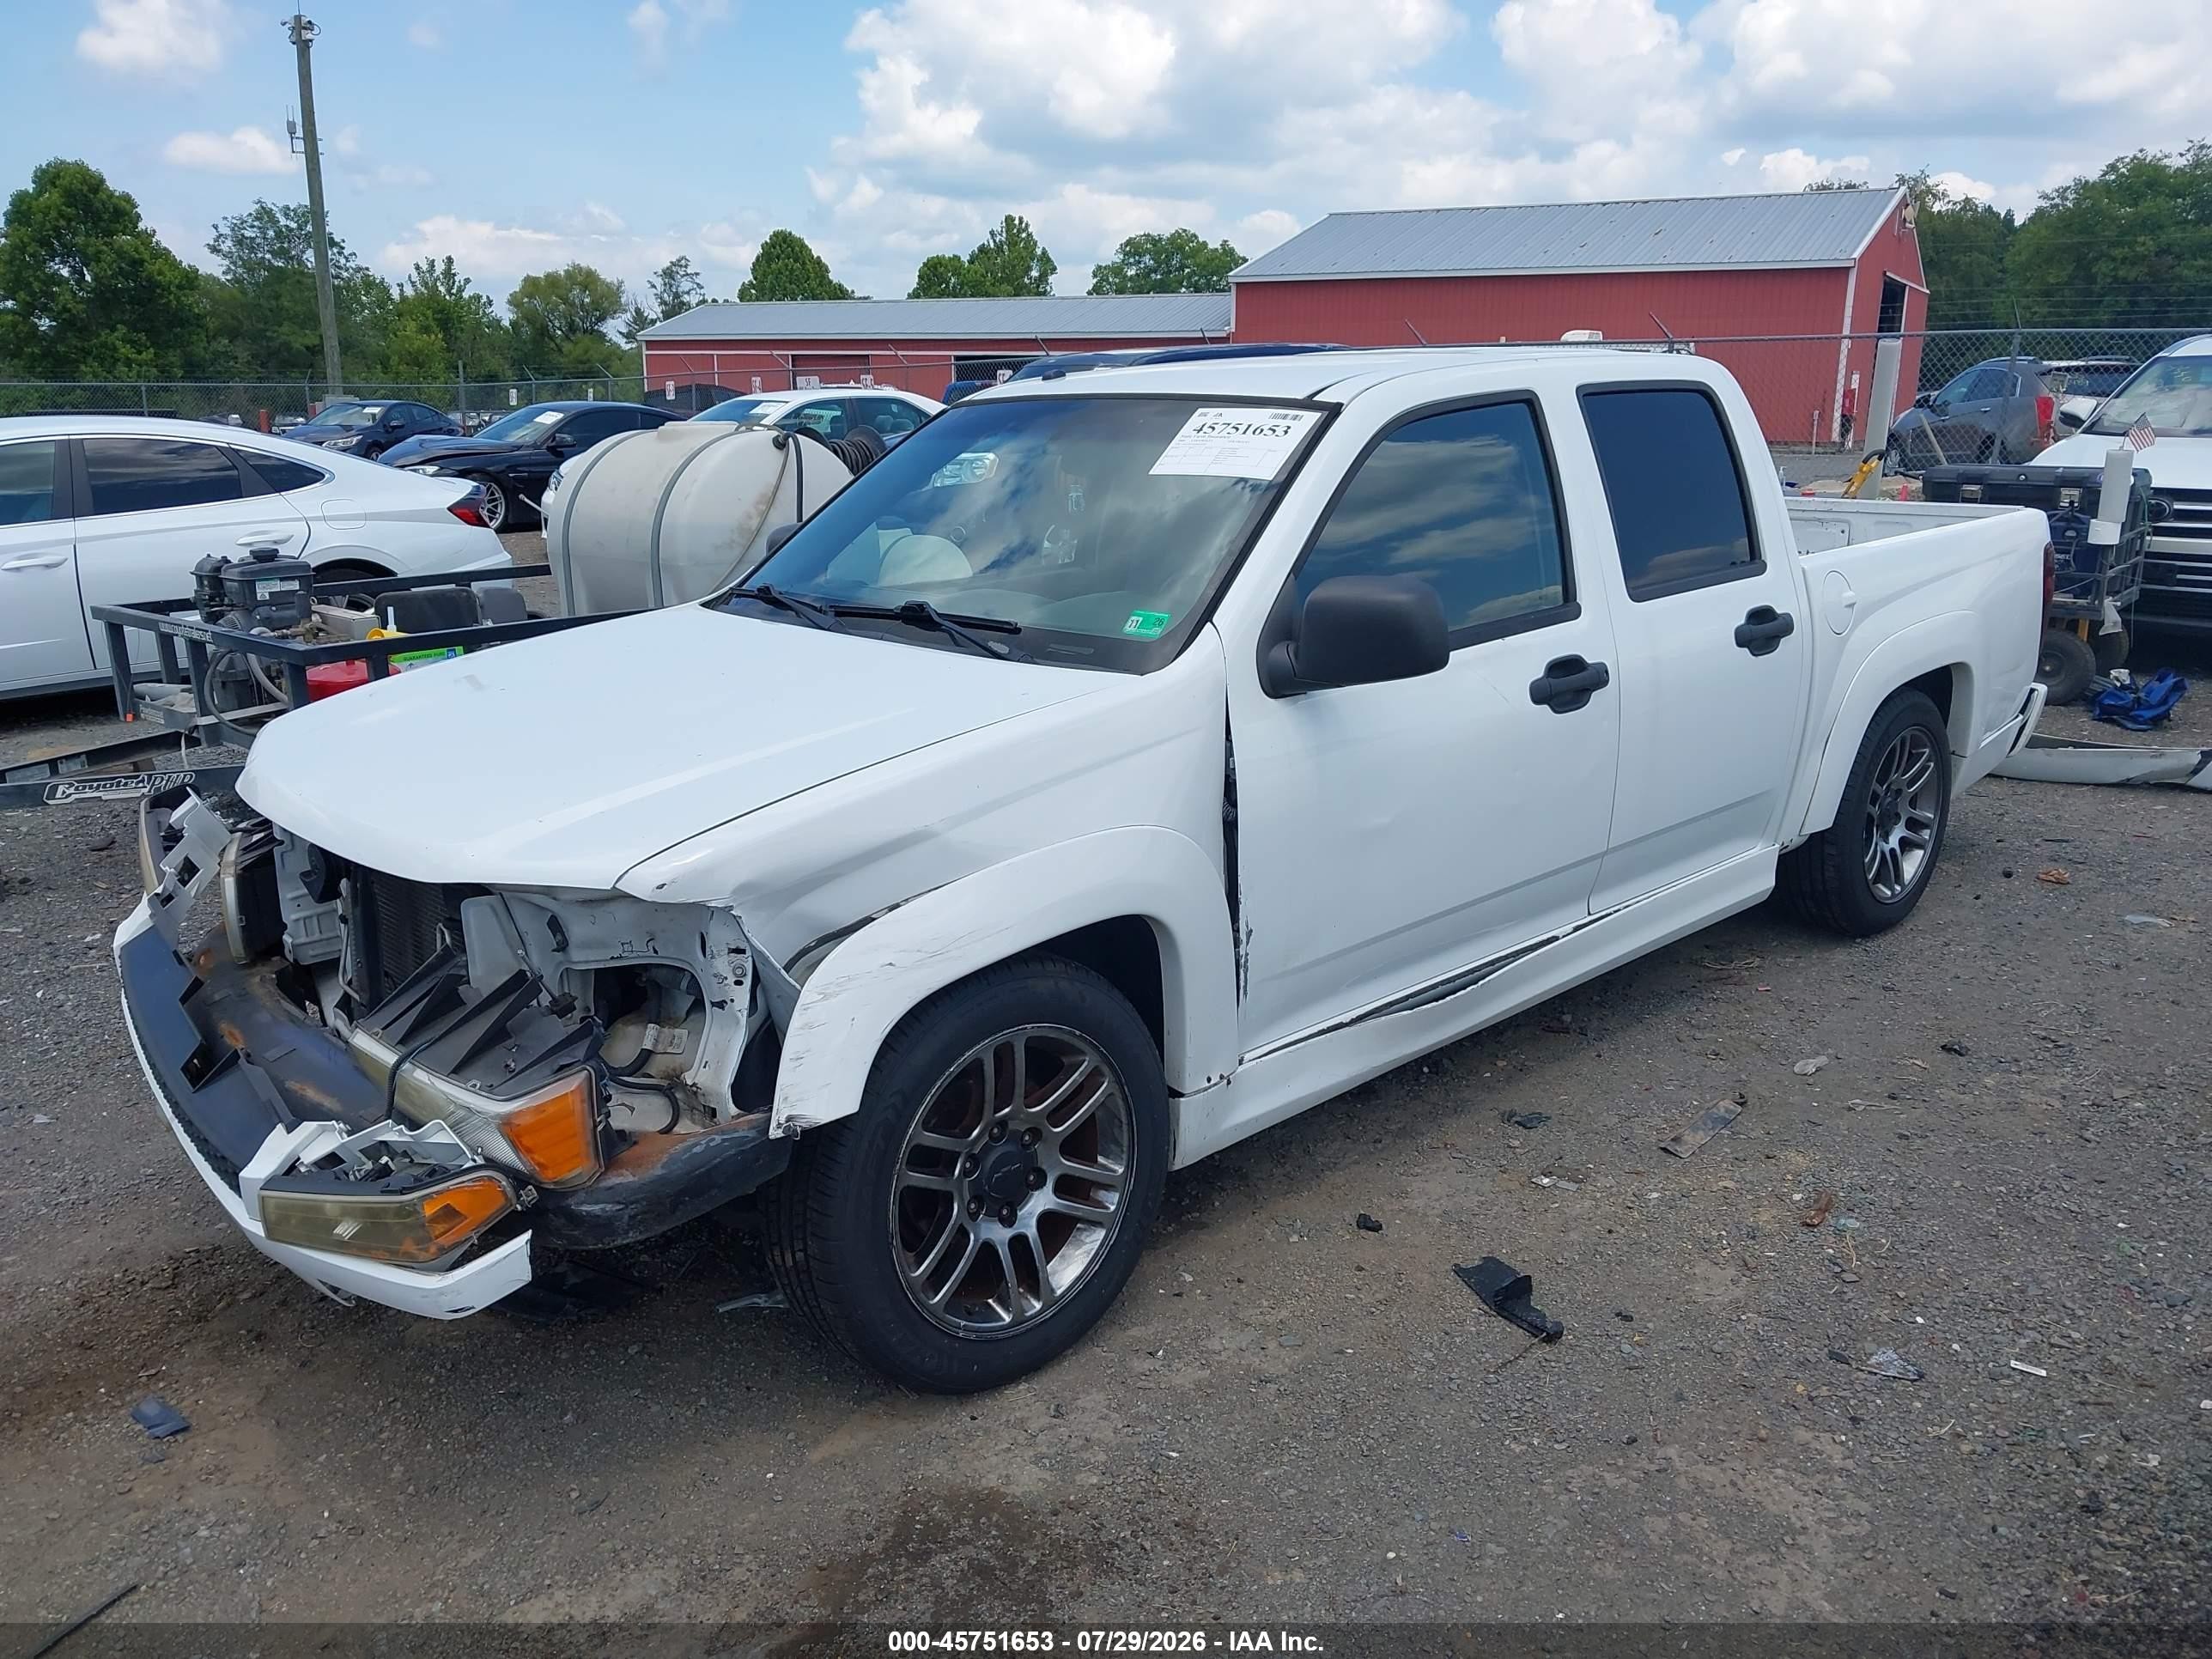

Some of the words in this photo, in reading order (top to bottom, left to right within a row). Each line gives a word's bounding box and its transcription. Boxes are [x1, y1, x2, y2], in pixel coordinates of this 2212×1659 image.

[1192, 422, 1291, 438] 45751653
[1127, 618, 1139, 629] 11
[1153, 617, 1164, 626] 26
